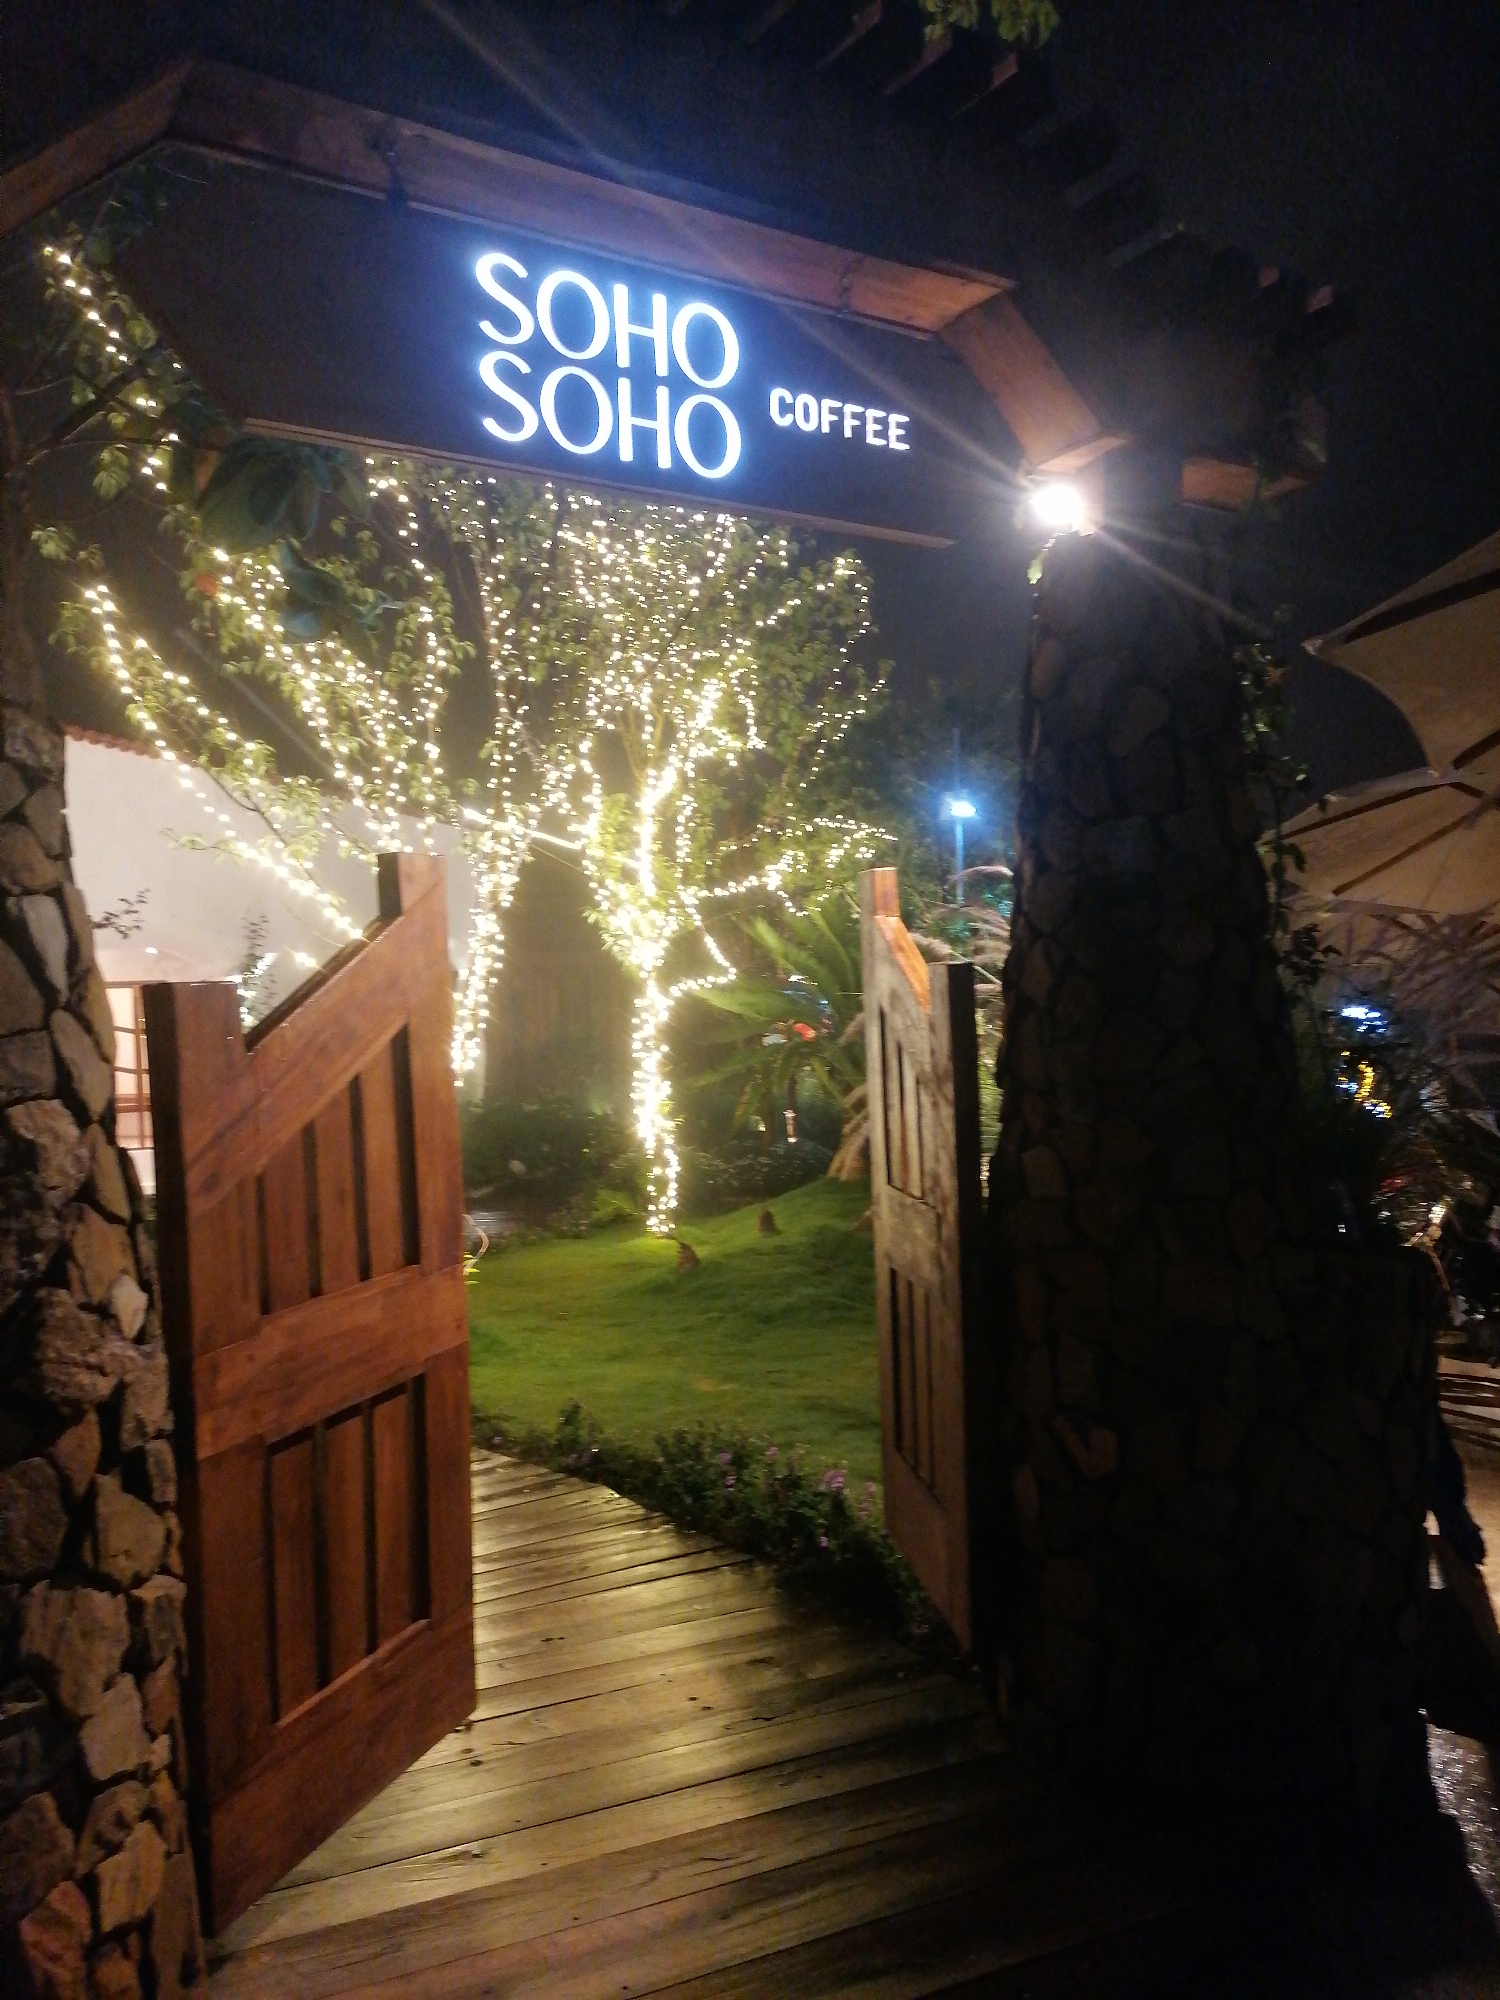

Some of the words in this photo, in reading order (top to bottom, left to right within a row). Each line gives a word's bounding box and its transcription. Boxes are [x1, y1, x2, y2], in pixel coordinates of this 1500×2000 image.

[474, 251, 740, 389] SOHO
[478, 350, 742, 479] SOHO
[769, 387, 911, 451] COFFEE
